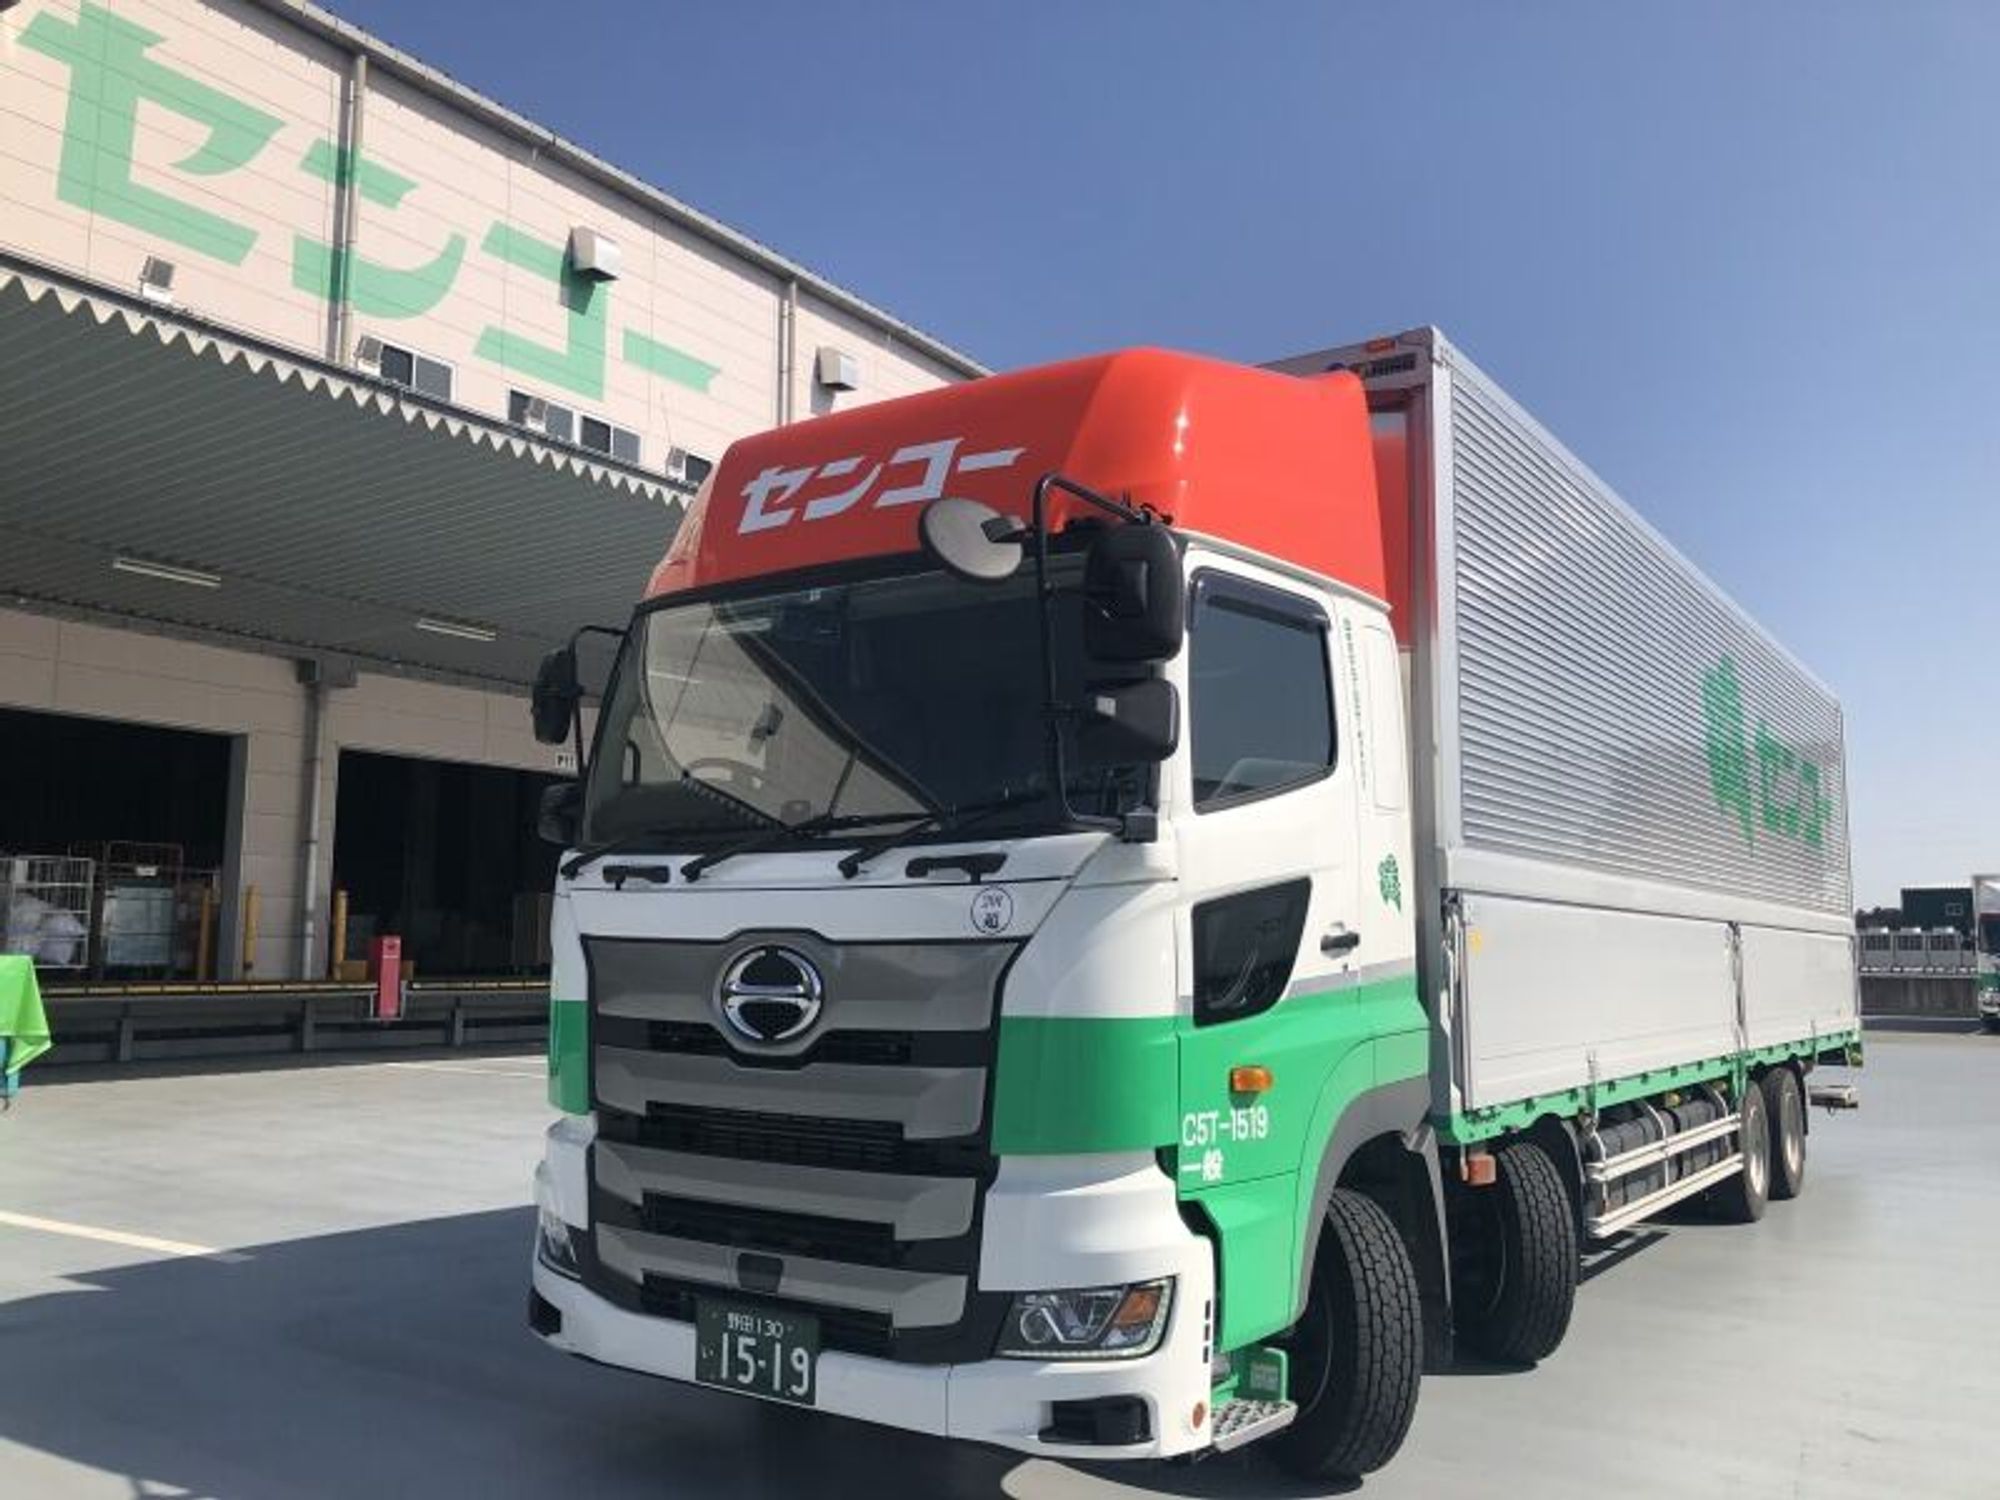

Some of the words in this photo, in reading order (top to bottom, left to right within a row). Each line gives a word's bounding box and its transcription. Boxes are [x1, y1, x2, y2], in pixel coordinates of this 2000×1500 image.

[14, 0, 722, 402] センコー
[737, 437, 1027, 535] センコー
[1182, 1105, 1269, 1146] C5T-1519
[721, 1331, 809, 1396] 15-19
